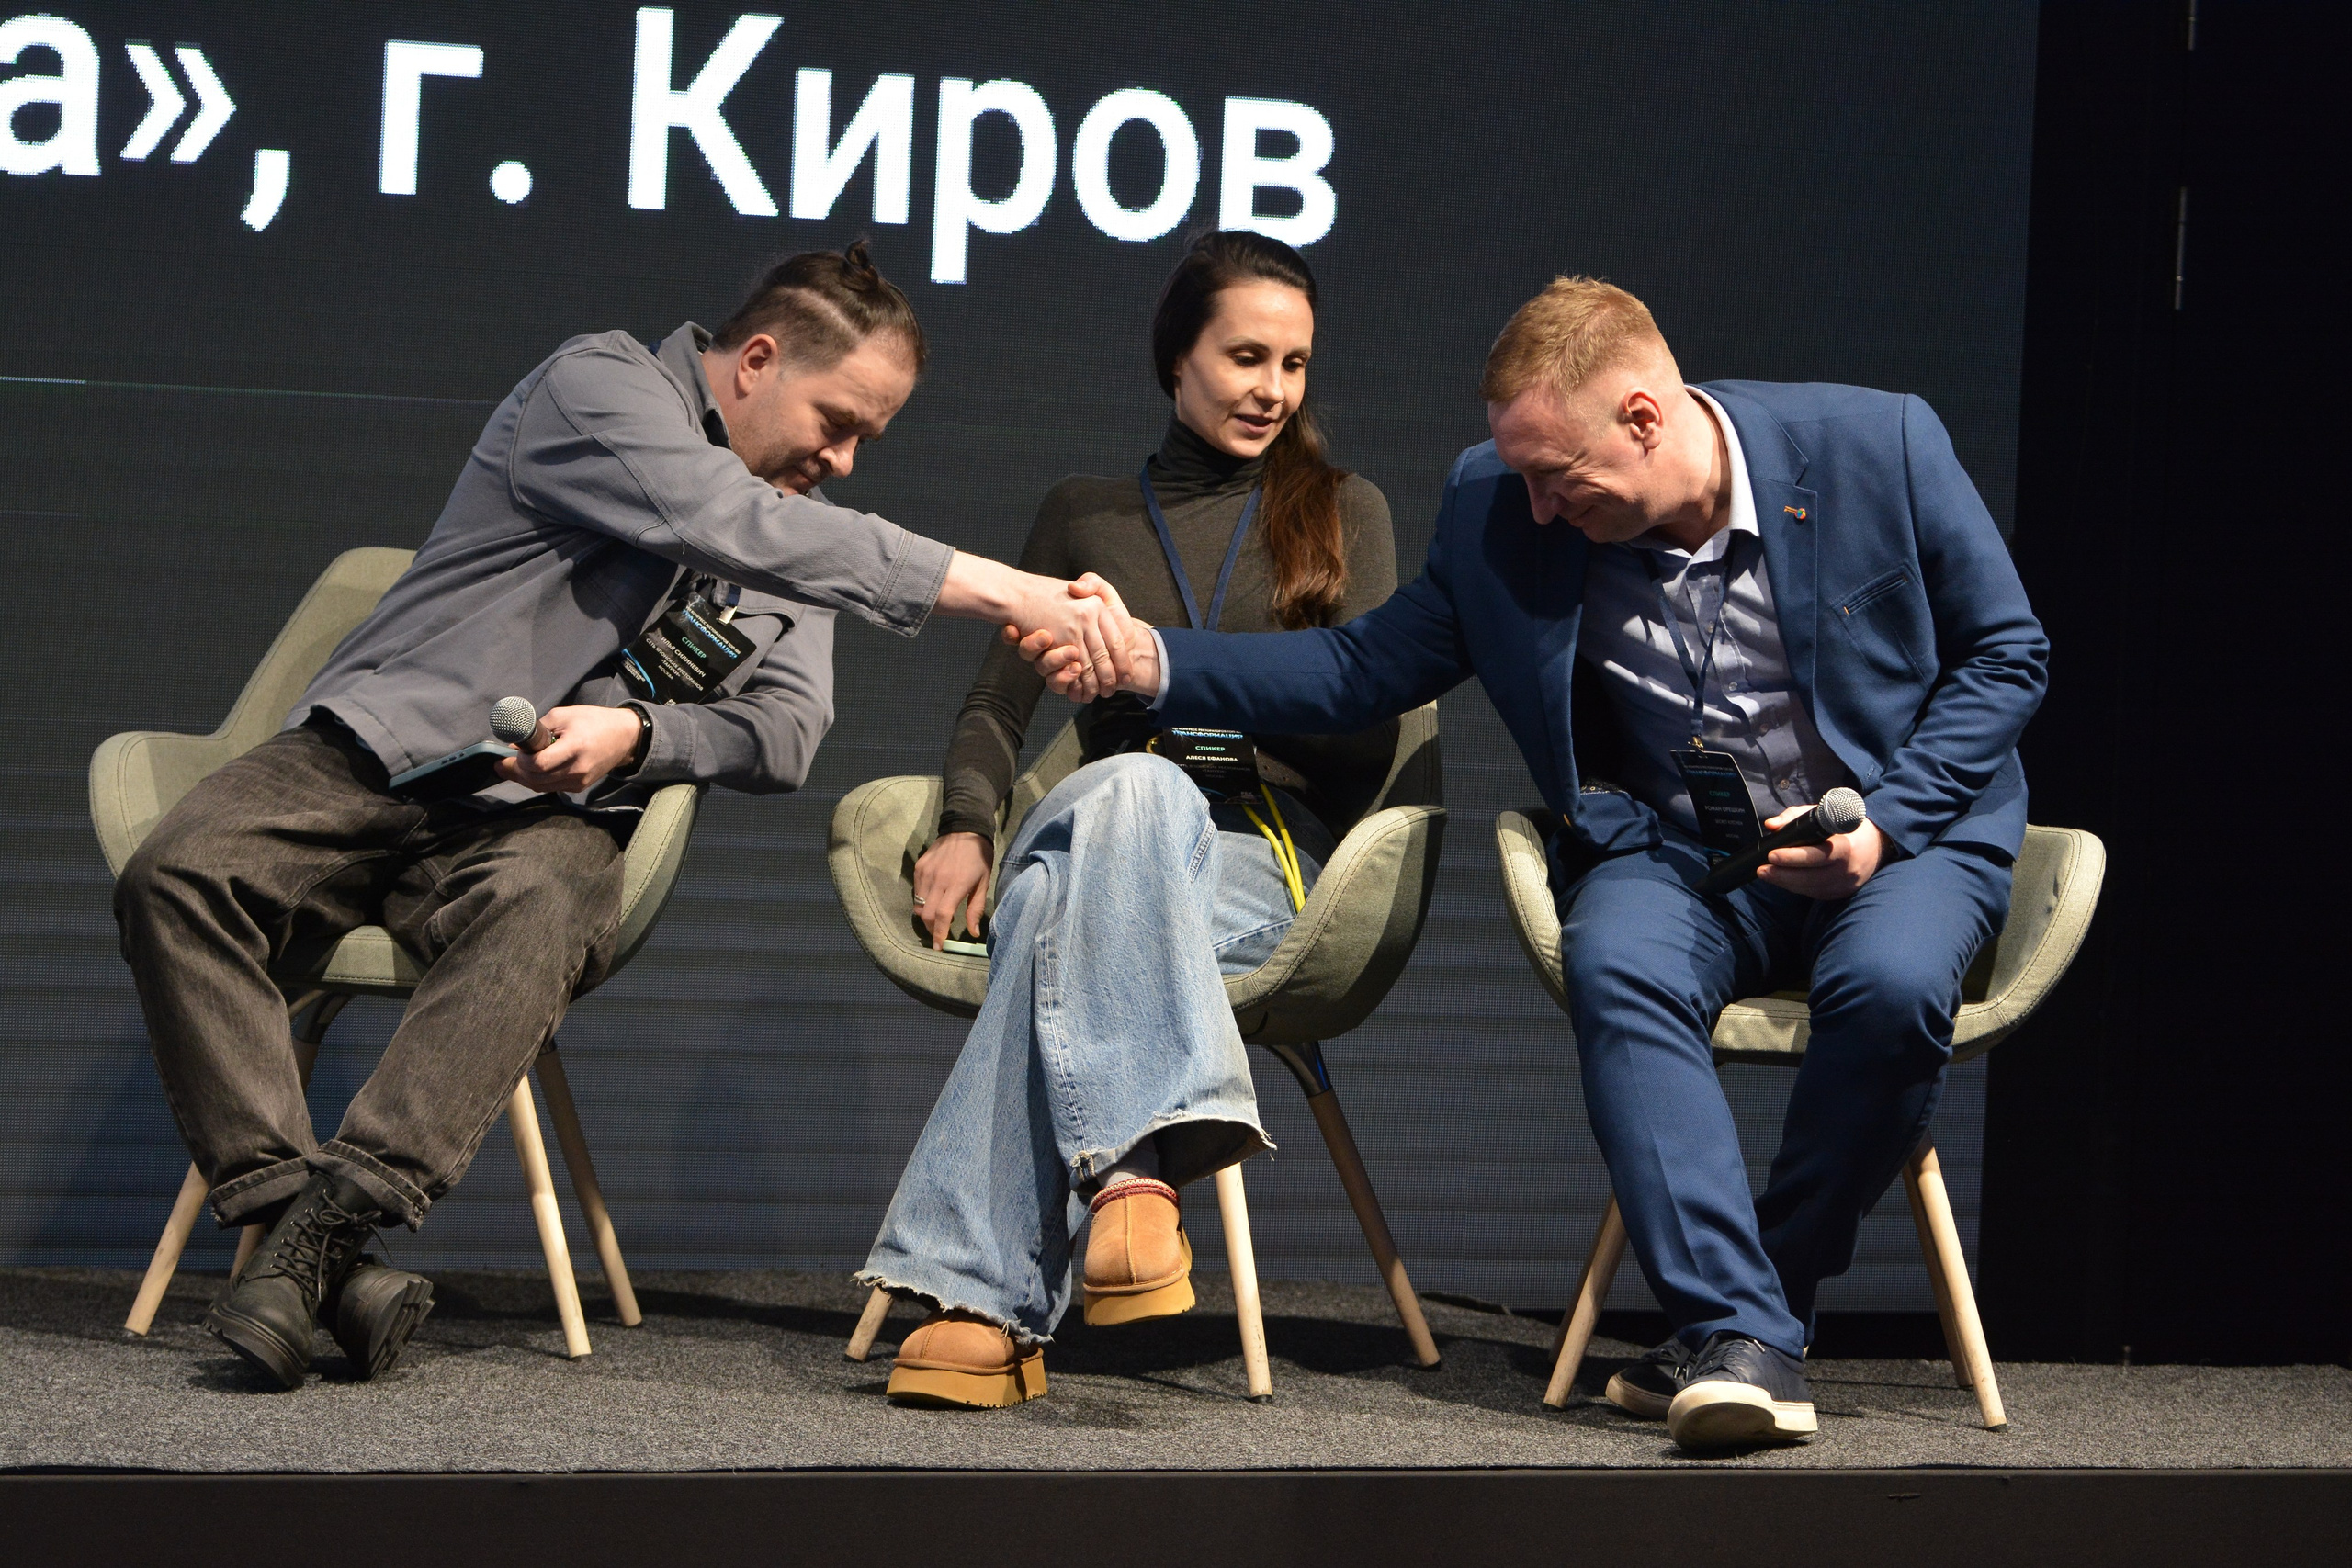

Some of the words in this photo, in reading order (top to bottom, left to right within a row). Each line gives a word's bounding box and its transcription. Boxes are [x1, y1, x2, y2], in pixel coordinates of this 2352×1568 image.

[379, 39, 533, 204] г.
[628, 7, 1336, 284] Киров
[645, 637, 656, 649] СЕТЬ
[655, 647, 678, 668] ЯПОНСКИХ
[676, 666, 704, 691] РЕСТОРАНОВ
[660, 637, 675, 650] ИЛЬЯ
[673, 649, 706, 677] СИЛИНЕВИЧ
[681, 636, 707, 660] СПИКЕР
[658, 664, 673, 679] МОСКВА
